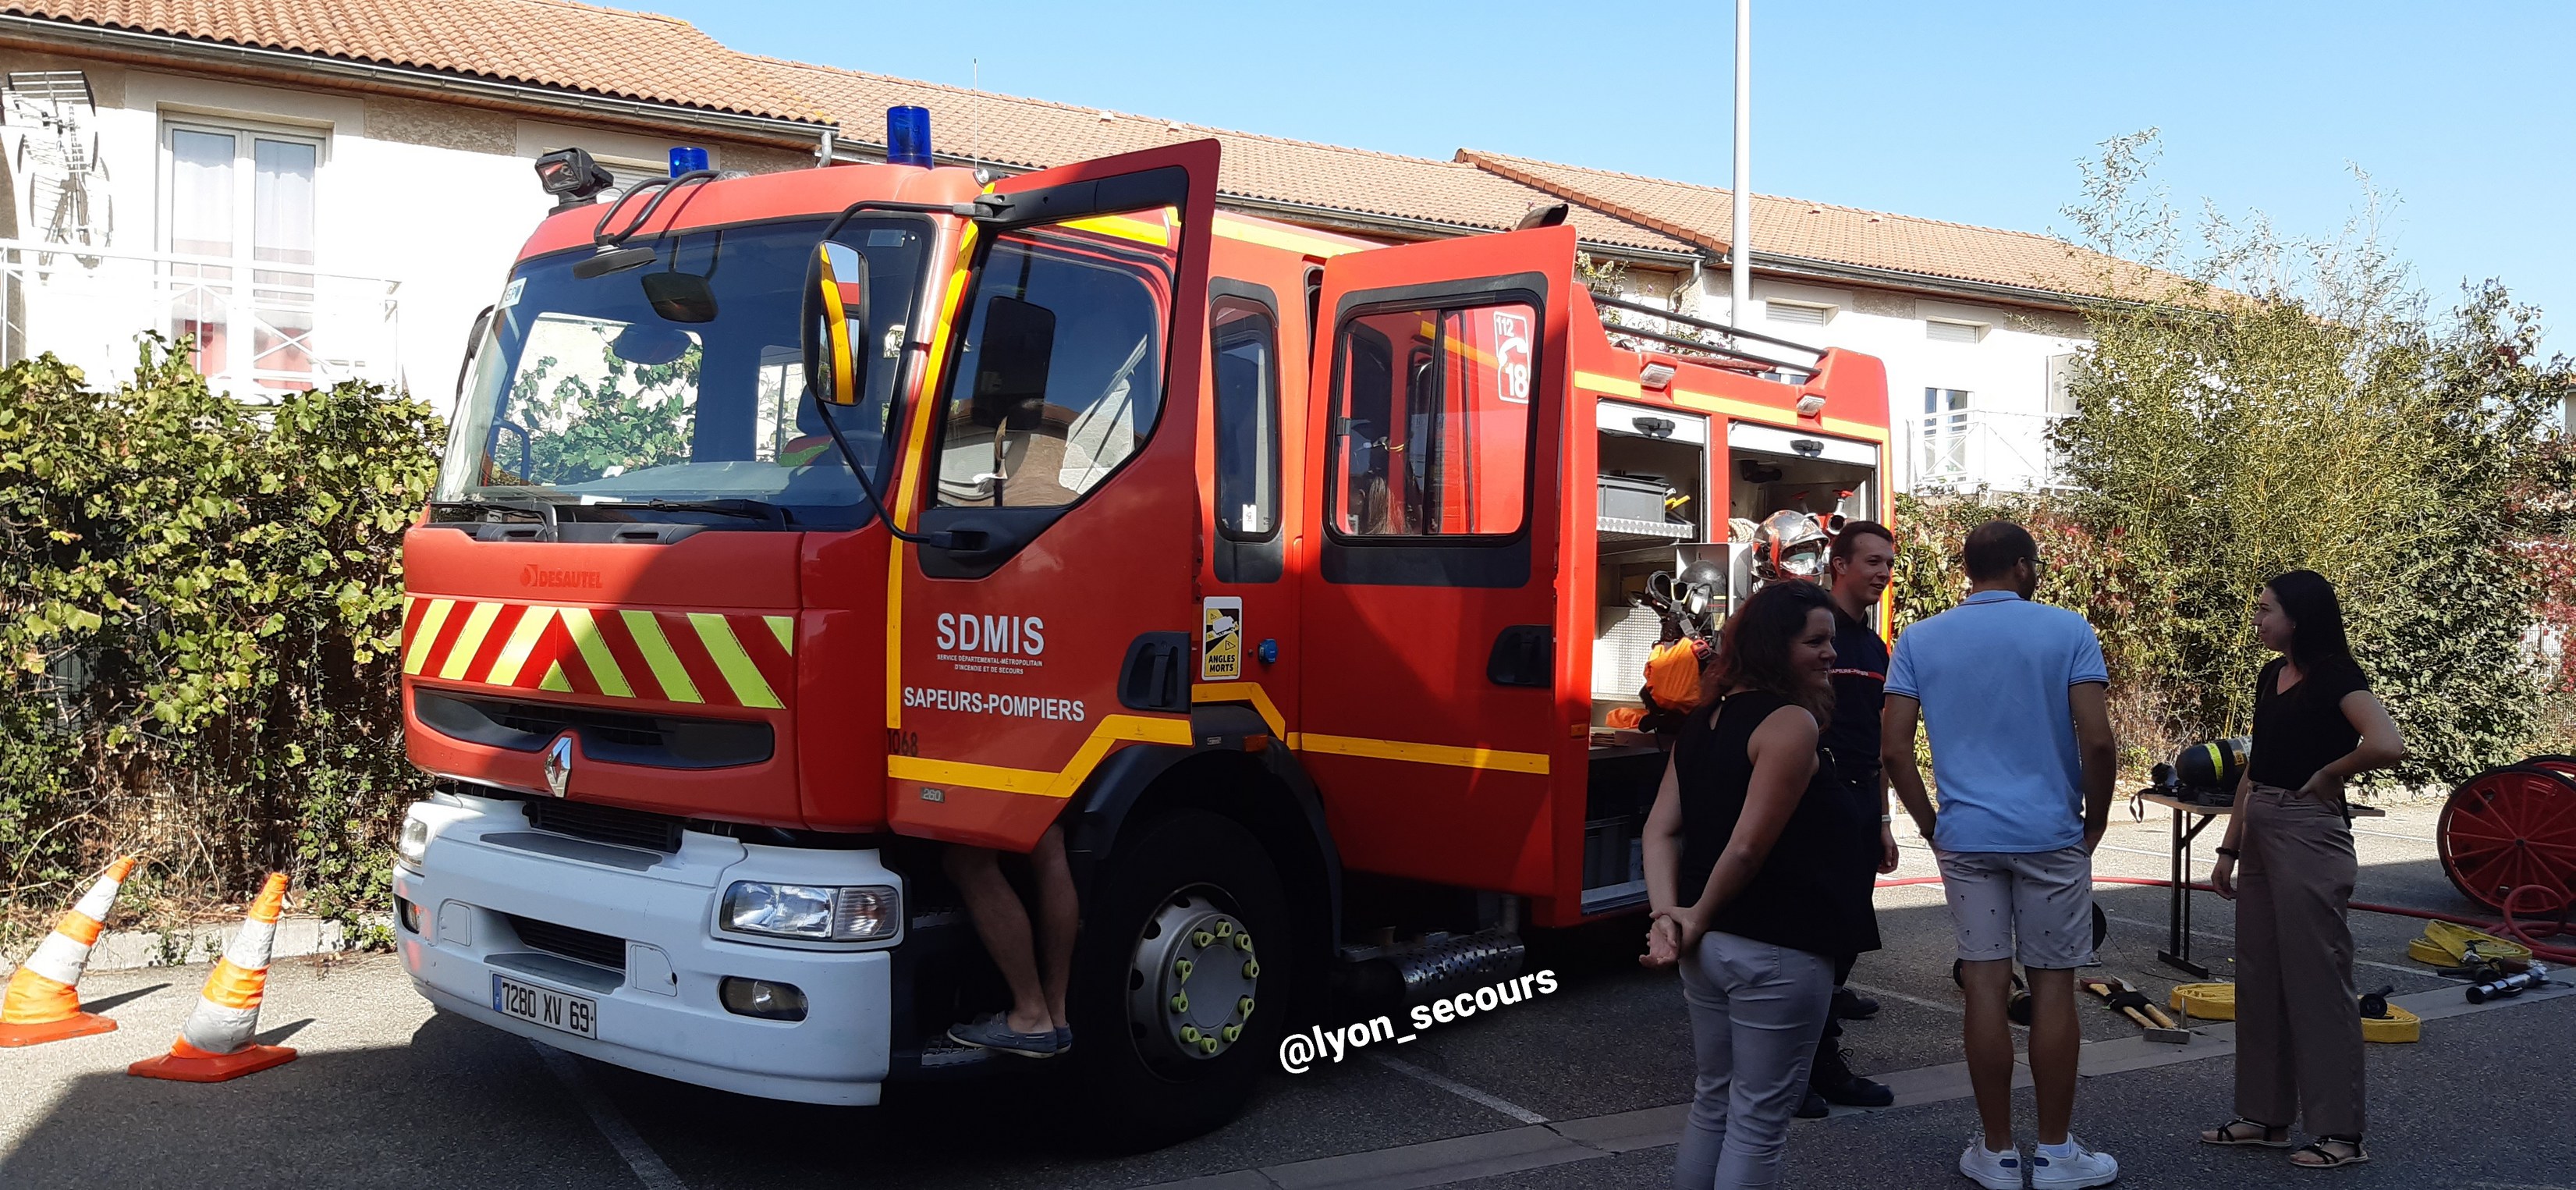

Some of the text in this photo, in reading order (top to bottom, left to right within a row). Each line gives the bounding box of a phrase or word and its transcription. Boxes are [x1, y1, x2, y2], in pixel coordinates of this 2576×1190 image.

[1496, 316, 1514, 338] 112
[1505, 363, 1528, 399] 18
[539, 570, 603, 589] DESAUTEL
[937, 612, 1045, 655] SDMIS
[954, 664, 982, 673] D'INCENDIE
[958, 654, 1043, 666] DÉPARTEMENTAL-MÉTROPOLITAIN
[1208, 655, 1236, 664] ANGLES
[1209, 664, 1234, 673] MORTS
[903, 687, 1085, 722] SAPEURS-POMPIERS
[887, 728, 918, 757] 1068
[502, 982, 589, 1033] 7280 XV 69
